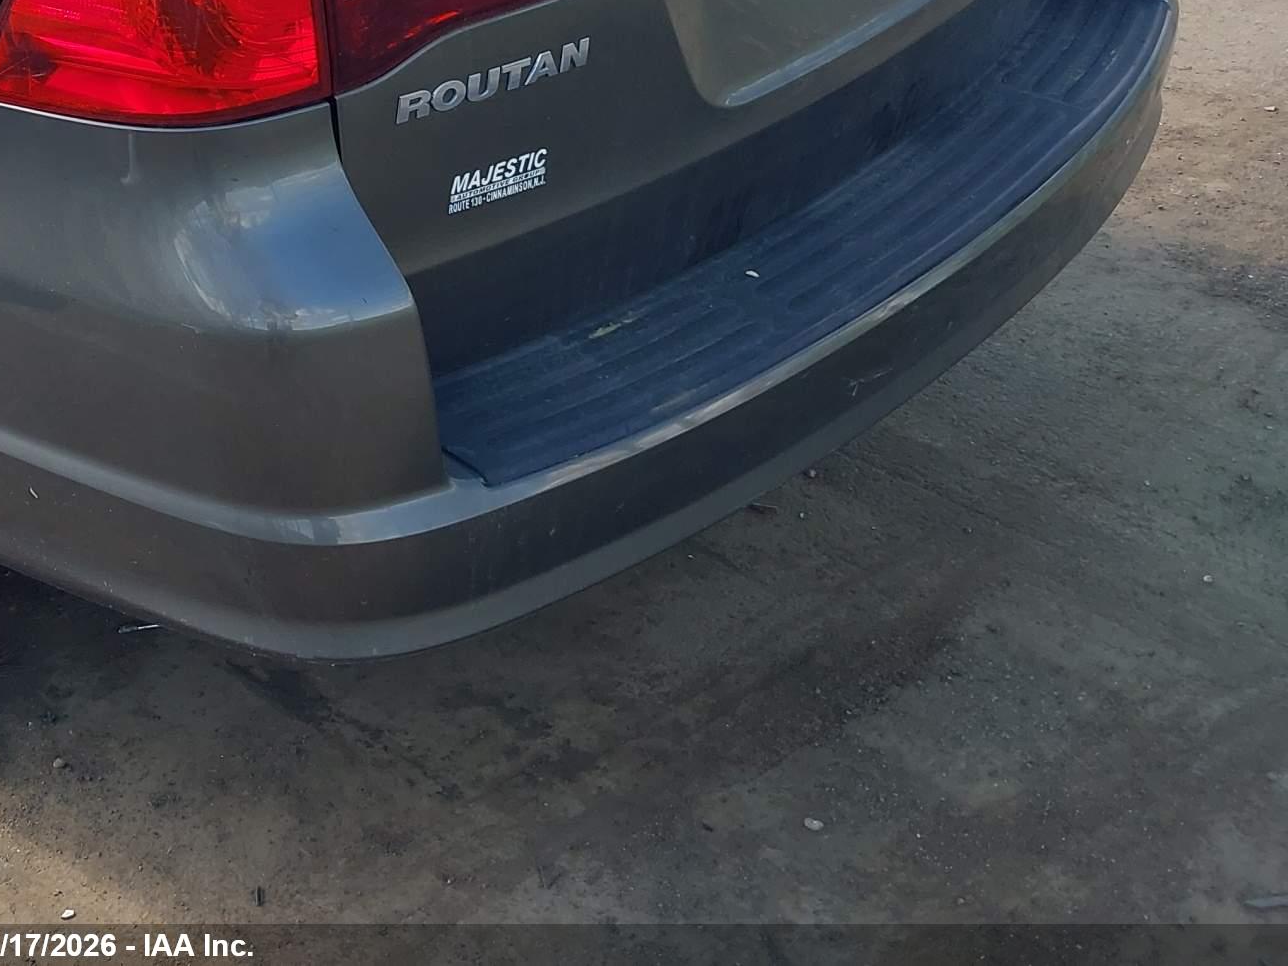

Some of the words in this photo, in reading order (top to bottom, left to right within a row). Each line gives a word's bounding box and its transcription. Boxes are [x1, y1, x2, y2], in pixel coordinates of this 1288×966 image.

[396, 37, 590, 124] ROUTAN
[451, 149, 547, 194] MAJESTIC
[448, 199, 470, 214] ROUTE
